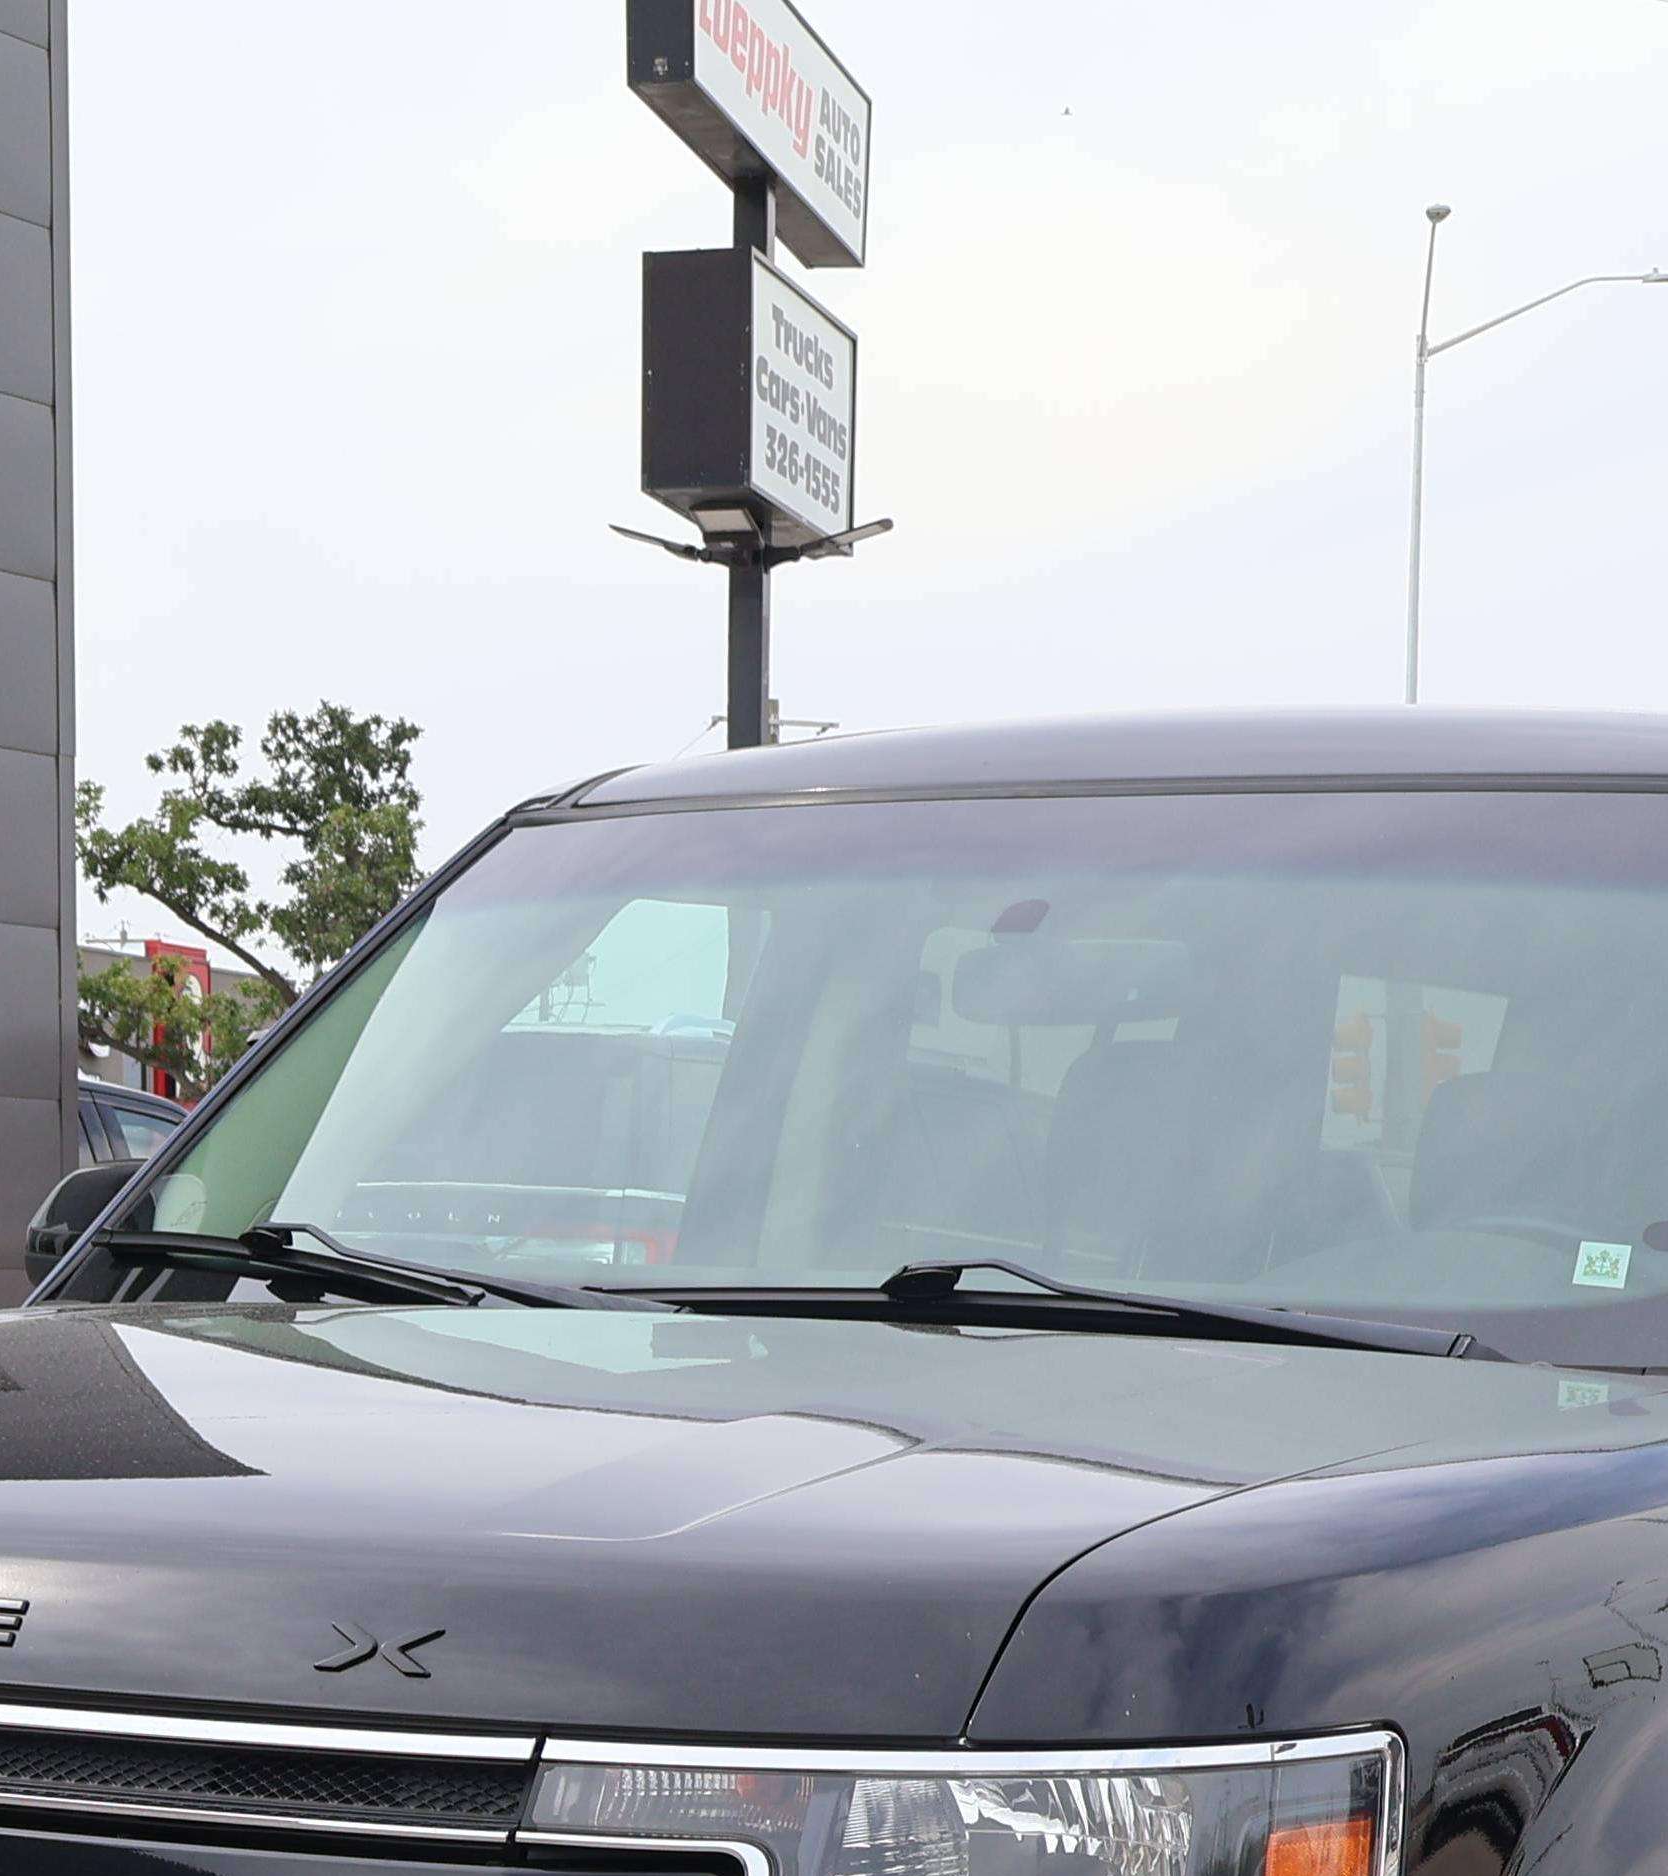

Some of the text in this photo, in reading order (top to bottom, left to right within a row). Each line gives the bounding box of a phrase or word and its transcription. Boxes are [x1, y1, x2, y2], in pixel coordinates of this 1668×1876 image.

[820, 87, 860, 167] AUTO
[814, 133, 862, 220] SALES
[772, 303, 833, 391] Trucks
[765, 424, 840, 515] 326-1555
